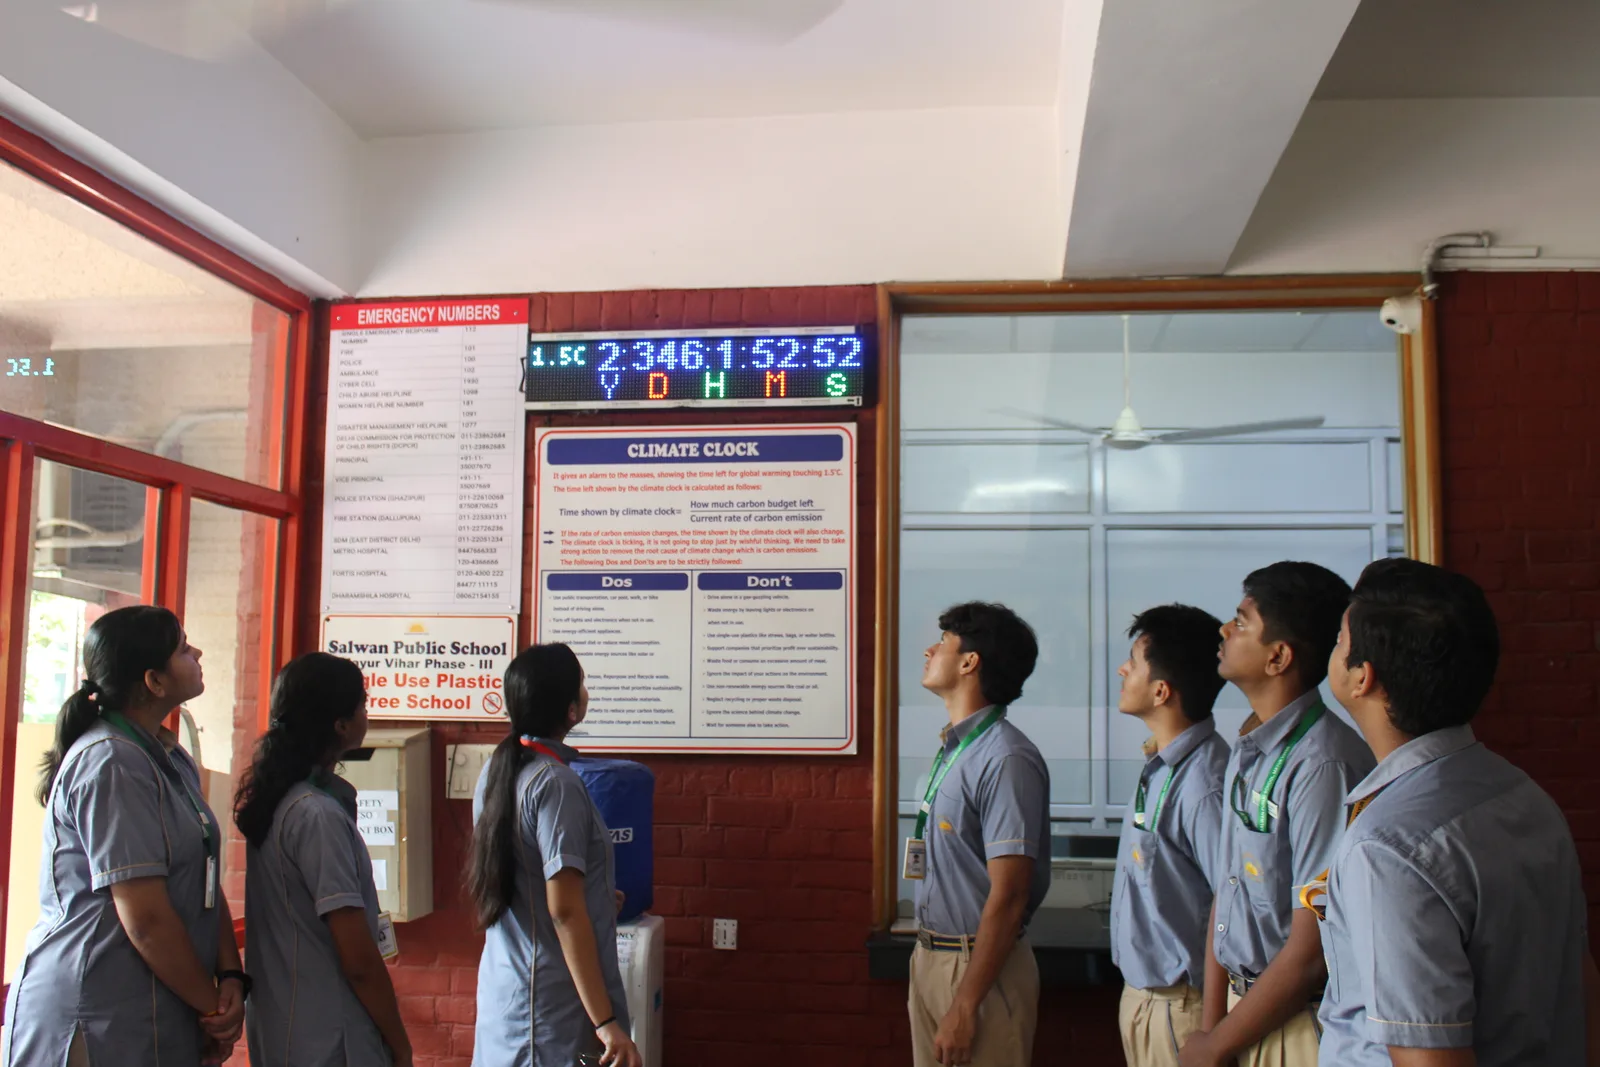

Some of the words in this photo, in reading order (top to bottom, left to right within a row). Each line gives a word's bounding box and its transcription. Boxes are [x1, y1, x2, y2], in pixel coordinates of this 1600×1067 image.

[358, 308, 434, 324] EMERGENCY
[438, 305, 500, 322] NUMBERS
[532, 345, 585, 366] 1.5C
[600, 374, 619, 399] Y
[649, 372, 668, 399] D
[705, 371, 724, 397] H
[765, 370, 784, 397] M
[827, 373, 846, 396] S
[627, 443, 699, 457] CLIMATE
[704, 442, 760, 456] CLOCK
[767, 500, 797, 508] budget
[610, 508, 620, 516] by
[602, 576, 632, 587] Dos
[747, 576, 792, 586] Don't
[328, 641, 388, 654] Salwan
[393, 641, 446, 654] Public
[450, 642, 506, 655] School
[352, 660, 381, 671] ayur
[385, 659, 420, 669] Vihar
[425, 659, 465, 669] Phase
[479, 660, 492, 669] III
[395, 673, 430, 687] Use
[437, 674, 502, 688] Plastic
[407, 694, 470, 709] School
